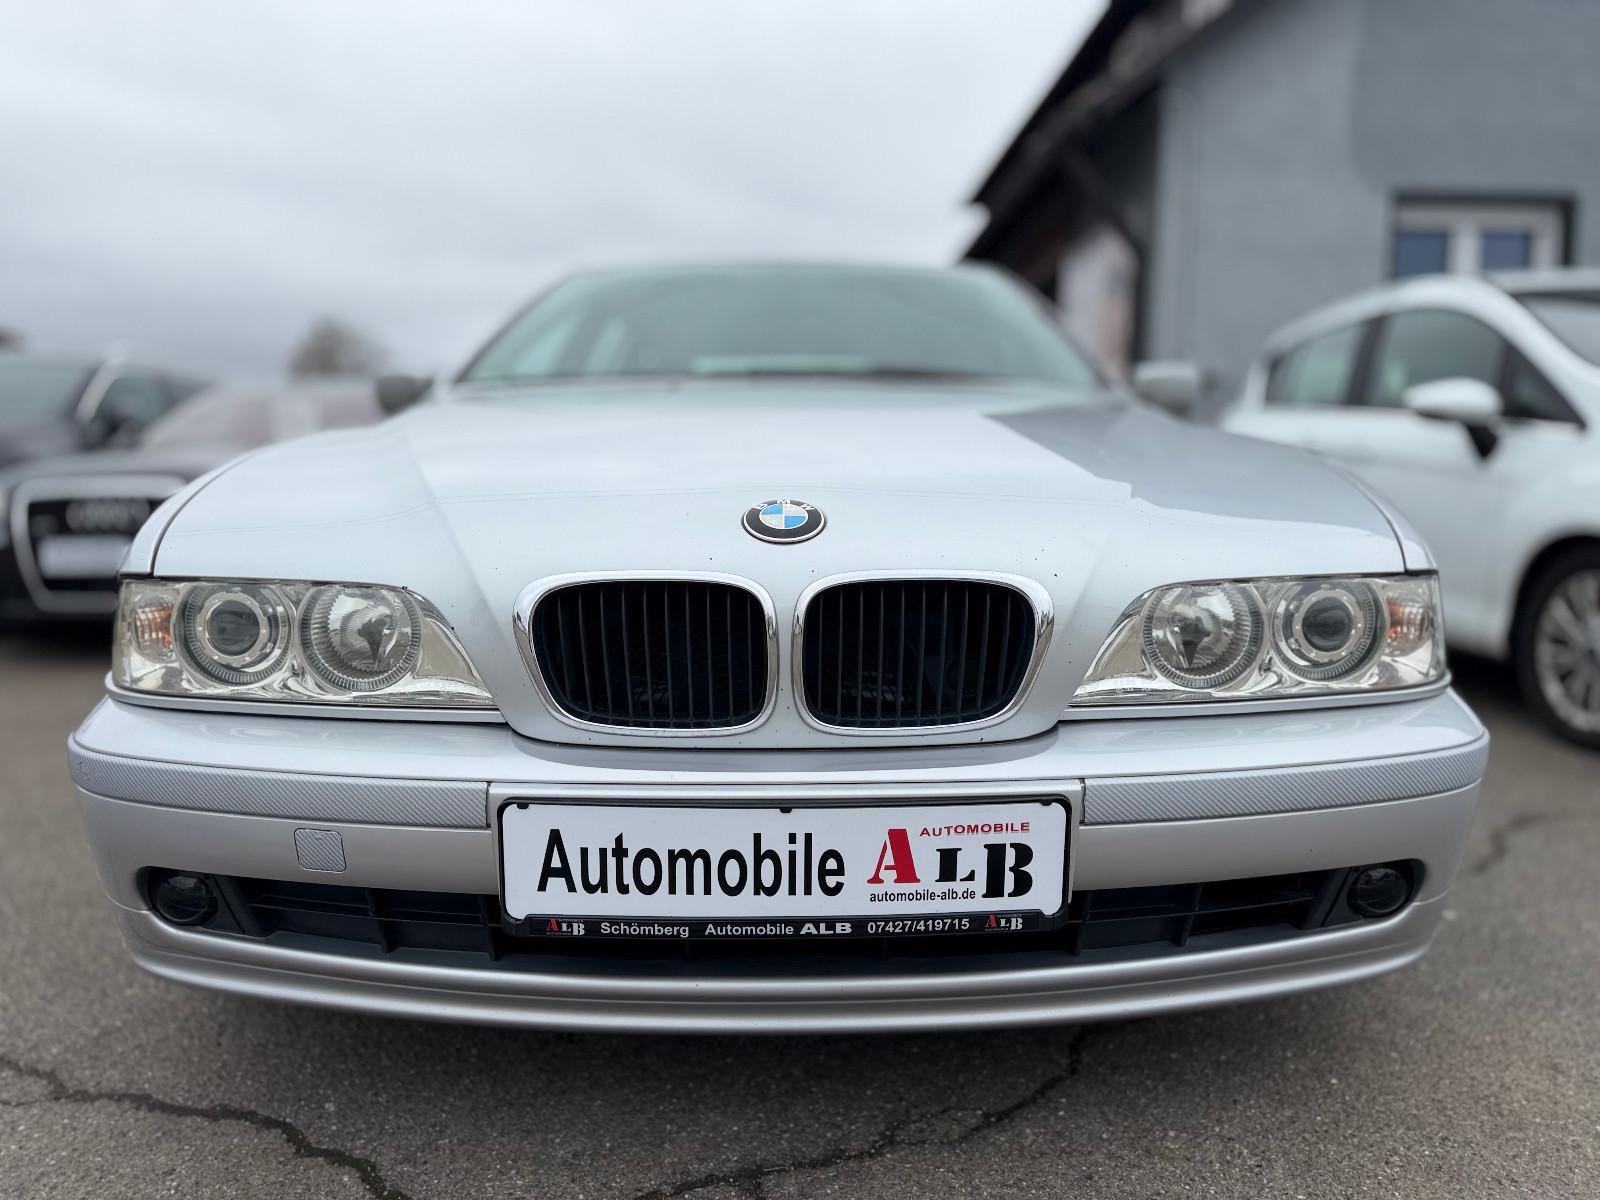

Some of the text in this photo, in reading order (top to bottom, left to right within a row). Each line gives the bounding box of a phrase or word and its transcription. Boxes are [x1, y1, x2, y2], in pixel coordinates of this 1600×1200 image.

[919, 822, 1031, 837] AUTOMOBILE
[536, 828, 846, 897] Automobile
[866, 828, 1034, 899] ALB
[869, 887, 977, 903] automobile-alb.de
[600, 918, 971, 938] Schömberg Automobile ALB 07427/419715
